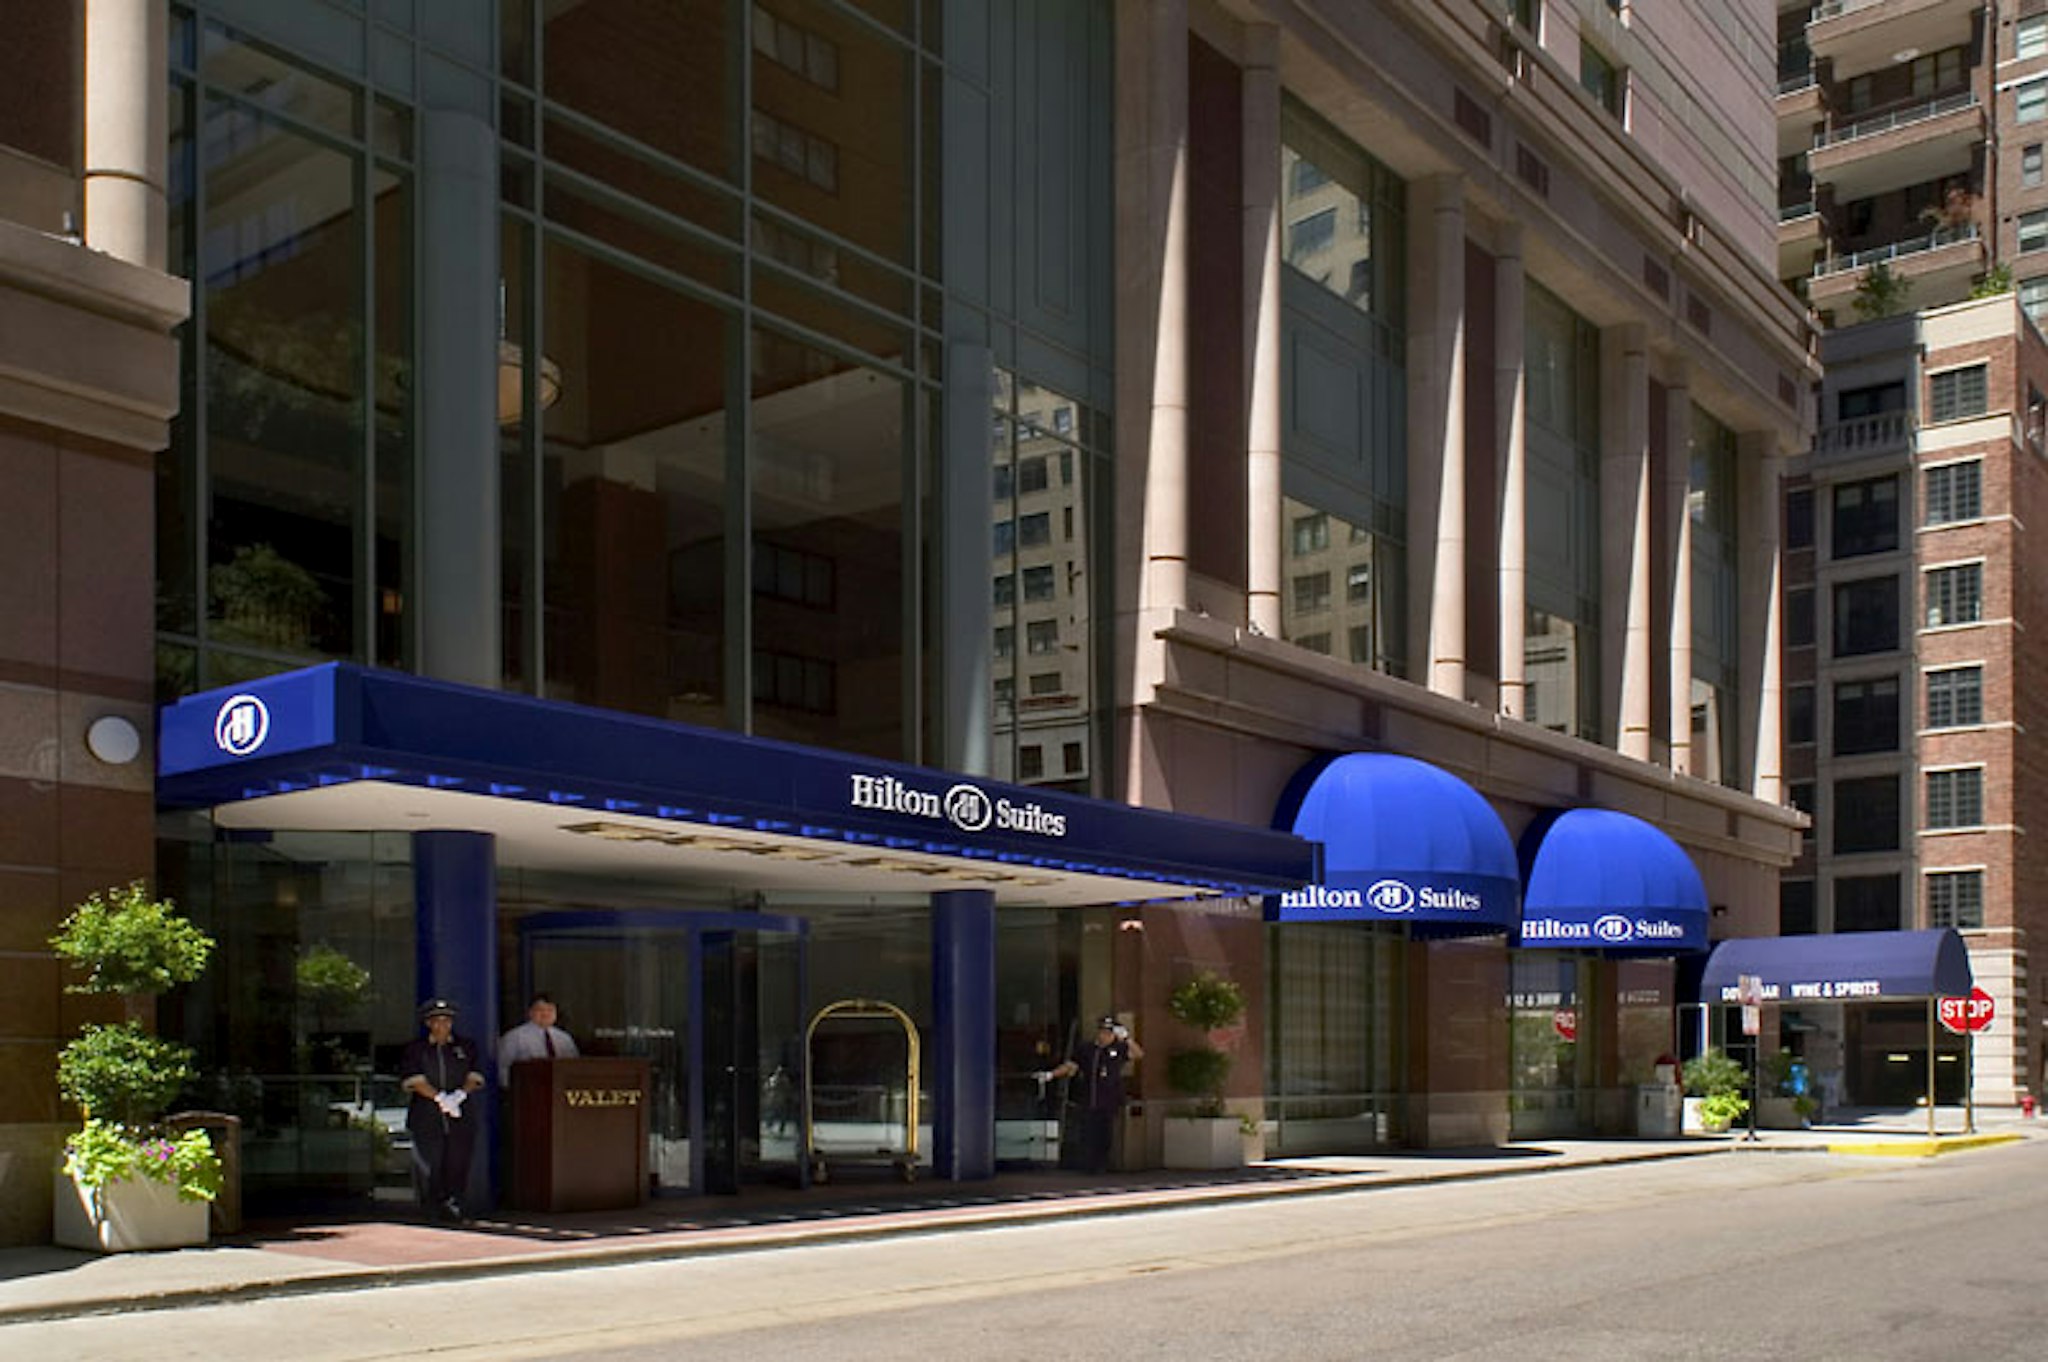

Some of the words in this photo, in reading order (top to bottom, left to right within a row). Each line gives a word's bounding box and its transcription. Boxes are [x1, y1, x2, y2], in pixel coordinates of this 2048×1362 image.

[851, 774, 942, 818] Hilton
[996, 799, 1066, 836] Suites
[1281, 884, 1362, 908] Hilton
[1419, 887, 1481, 909] Suites
[1521, 918, 1591, 938] Hilton
[1635, 919, 1684, 938] Suites
[1791, 982, 1821, 997] WINE
[1823, 982, 1832, 997] &
[1942, 999, 1993, 1019] STOP
[565, 1089, 642, 1106] VALET
